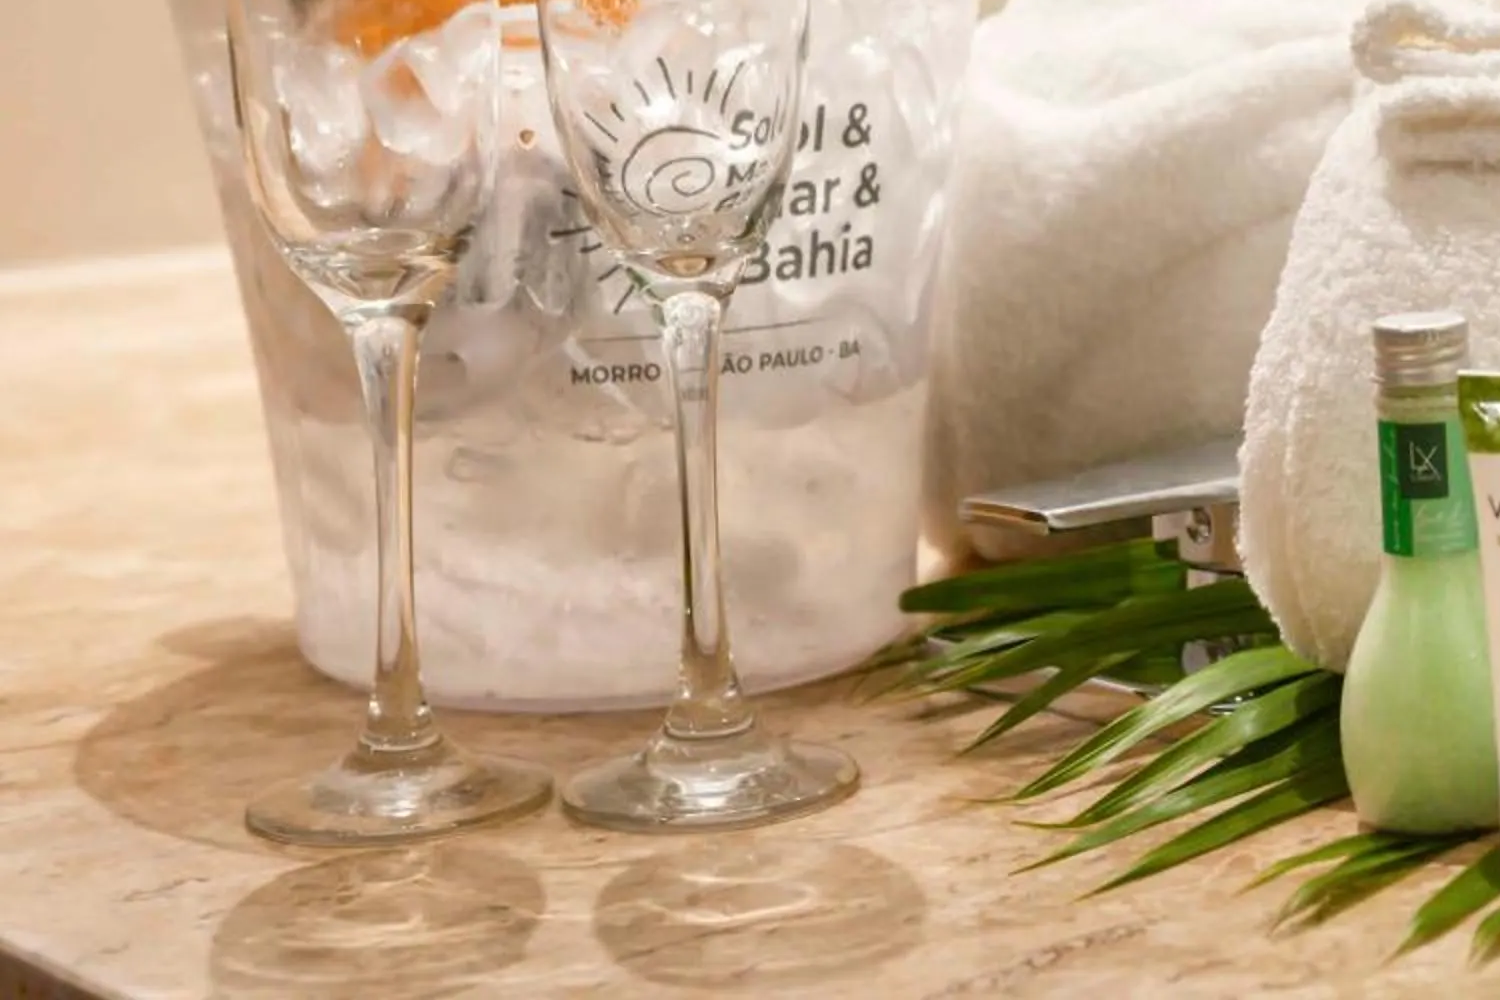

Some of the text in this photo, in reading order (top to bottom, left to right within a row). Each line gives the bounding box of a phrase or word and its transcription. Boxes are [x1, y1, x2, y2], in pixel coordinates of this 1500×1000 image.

[842, 103, 872, 149] &
[854, 163, 880, 209] &
[570, 363, 661, 386] MORRO
[720, 352, 754, 375] ÃO
[759, 346, 825, 372] PAULO
